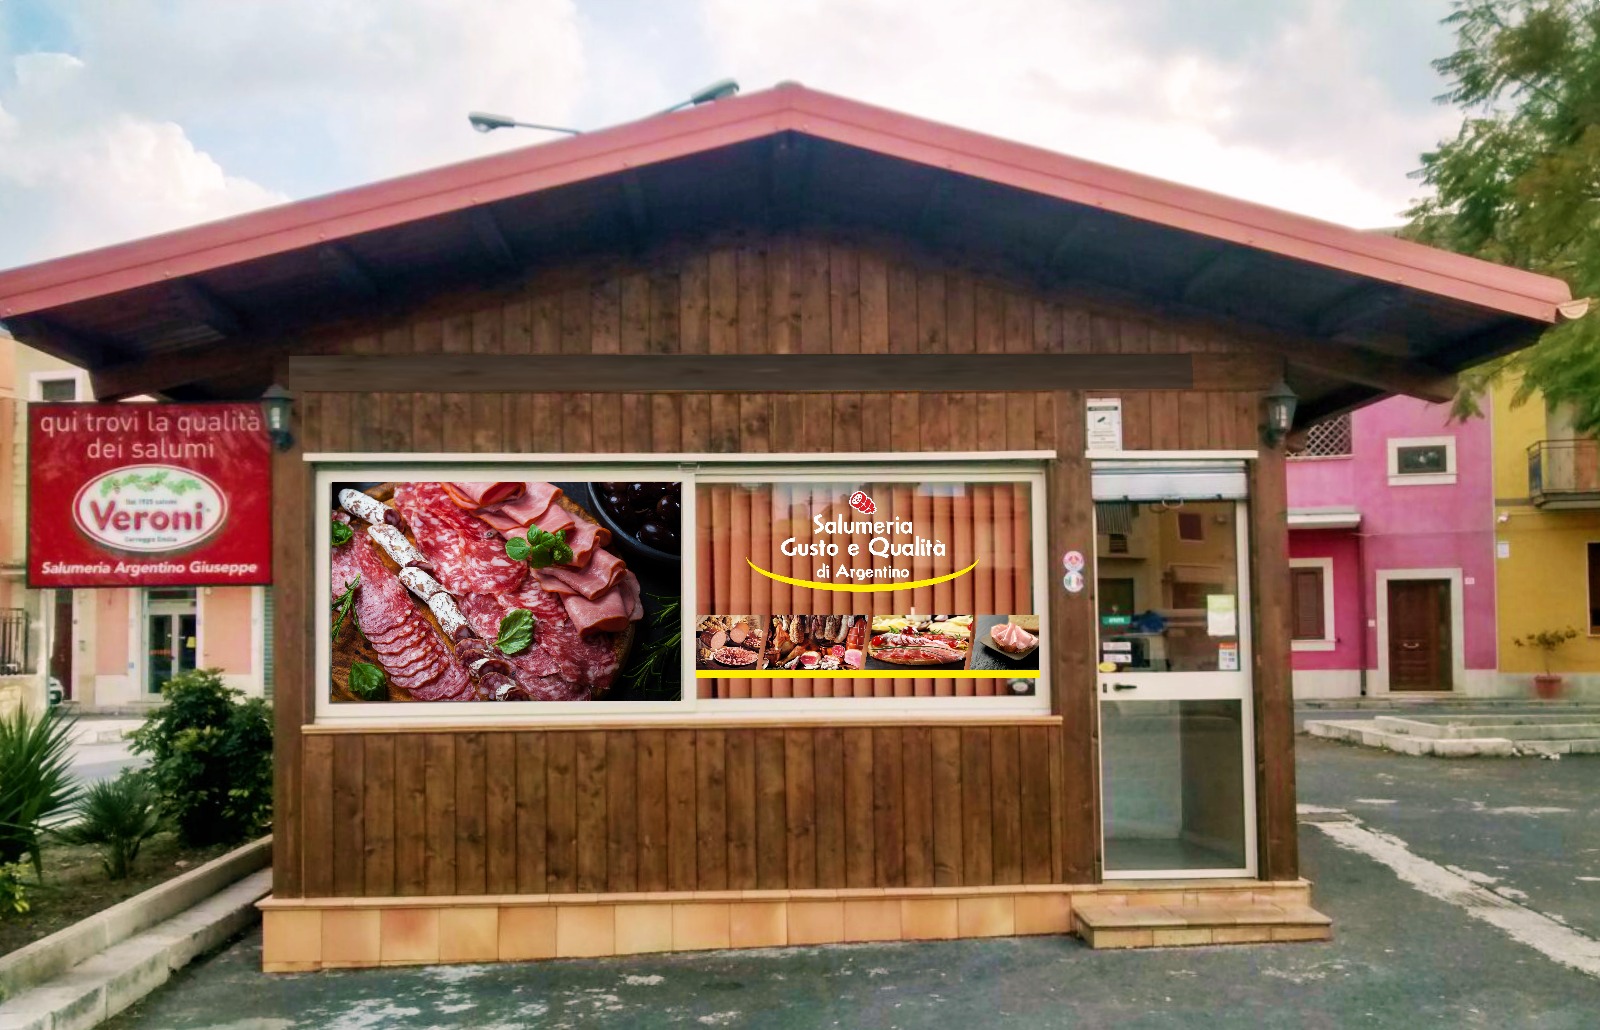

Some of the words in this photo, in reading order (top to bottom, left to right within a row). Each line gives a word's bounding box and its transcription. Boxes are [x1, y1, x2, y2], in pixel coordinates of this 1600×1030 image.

[41, 411, 77, 438] qui
[87, 412, 138, 432] trovi
[149, 411, 168, 432] la
[178, 410, 261, 437] qualità
[87, 437, 122, 458] dei
[132, 437, 214, 458] salumi
[90, 501, 203, 531] Veroni
[813, 513, 913, 535] Salumeria
[780, 536, 839, 557] Gusto
[848, 544, 860, 557] e
[868, 535, 946, 558] Qualità
[41, 561, 111, 575] Salumeria
[114, 562, 185, 577] Argentino
[189, 560, 258, 577] Giuseppe
[816, 563, 830, 579] di
[835, 564, 910, 580] Argentino
